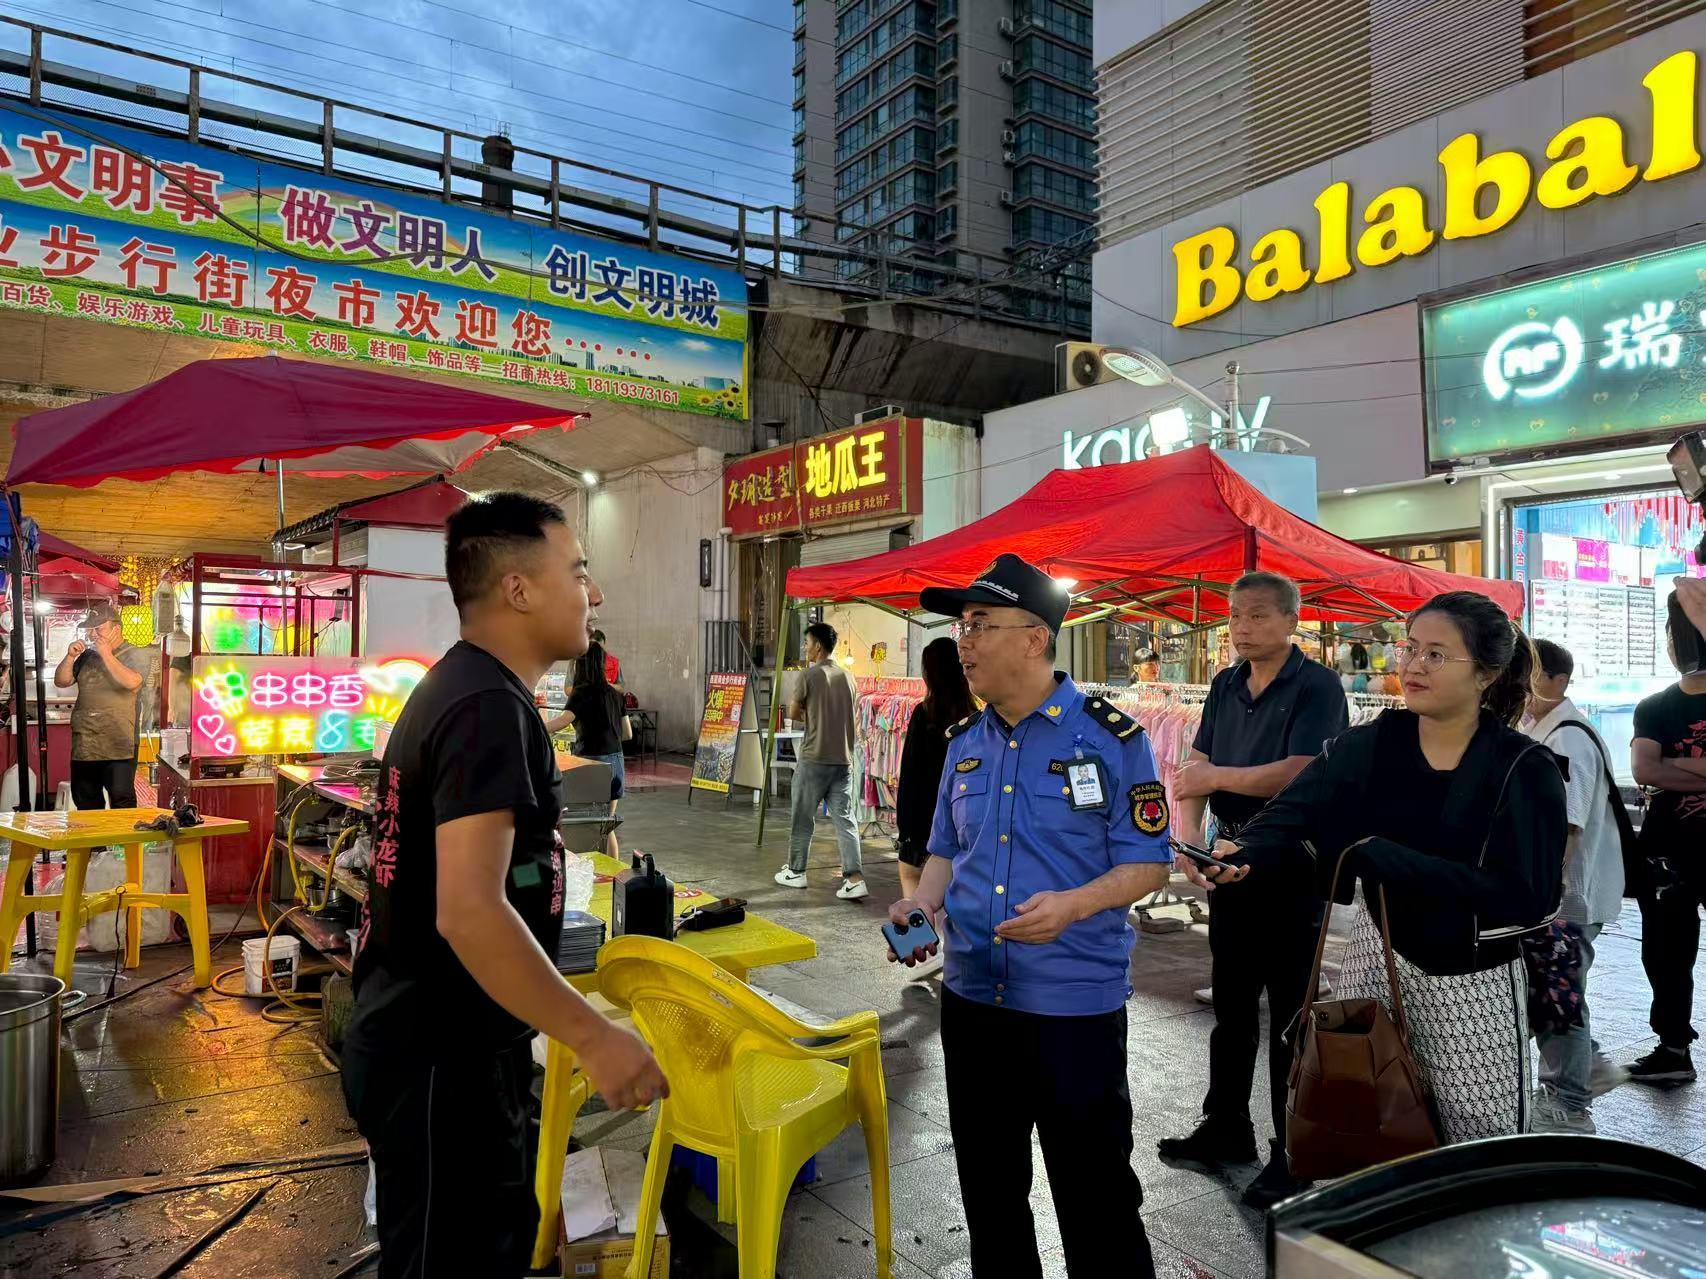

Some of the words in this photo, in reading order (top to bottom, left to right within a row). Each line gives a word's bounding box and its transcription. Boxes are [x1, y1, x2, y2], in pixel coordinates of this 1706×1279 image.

[1172, 50, 1701, 327] Balabal
[0, 133, 222, 223] 文明事
[281, 186, 497, 281] 做文明人
[546, 246, 719, 328] 创文明城
[1599, 301, 1706, 370] 瑞
[586, 377, 680, 404] 18119373161
[805, 431, 886, 497] 地瓜王
[250, 671, 364, 709] 串串香
